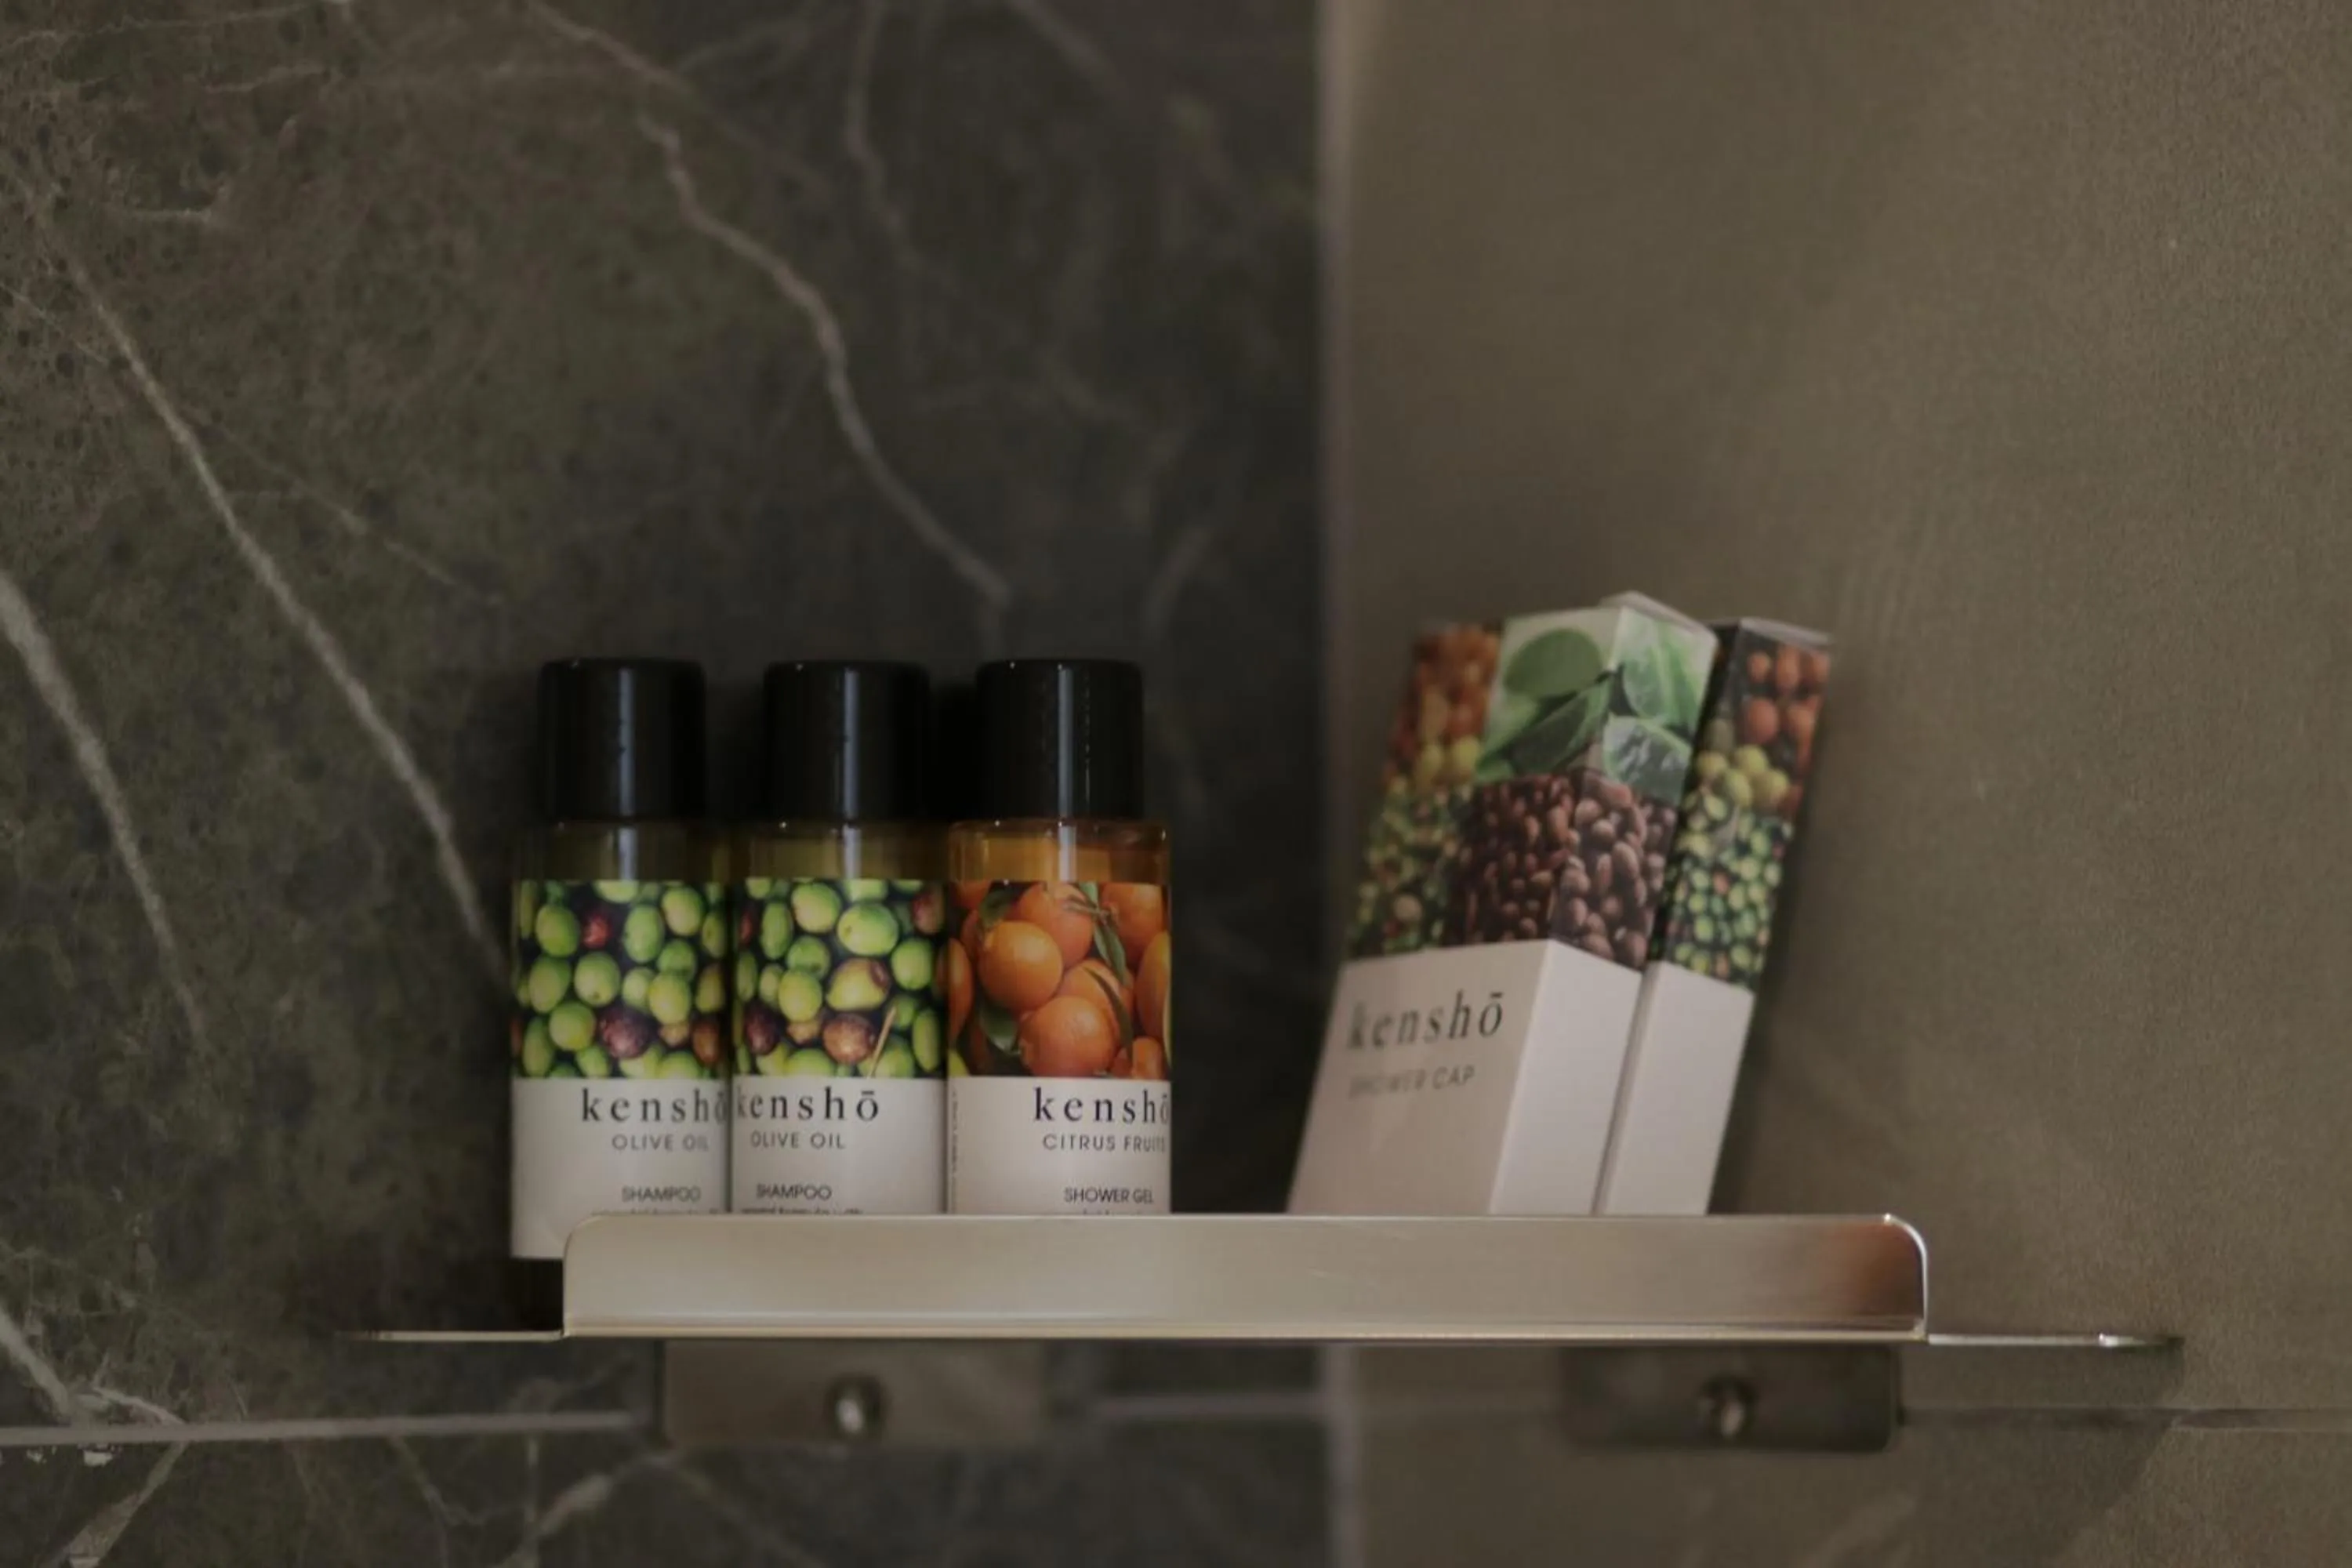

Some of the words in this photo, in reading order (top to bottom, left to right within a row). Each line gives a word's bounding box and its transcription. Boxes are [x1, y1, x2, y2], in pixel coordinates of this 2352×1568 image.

[1348, 989, 1504, 1049] kenshō
[1432, 1064, 1475, 1090] CAP
[737, 1085, 879, 1121] kenshō
[612, 1134, 673, 1152] OLIVE
[751, 1130, 799, 1149] OLIVE
[811, 1132, 846, 1150] OIL
[1043, 1134, 1116, 1152] CITRUS
[622, 1185, 701, 1203] SHAMPOO
[757, 1184, 833, 1200] SHAMPOO
[1065, 1188, 1130, 1203] SHOWER
[1133, 1189, 1154, 1203] GEL
